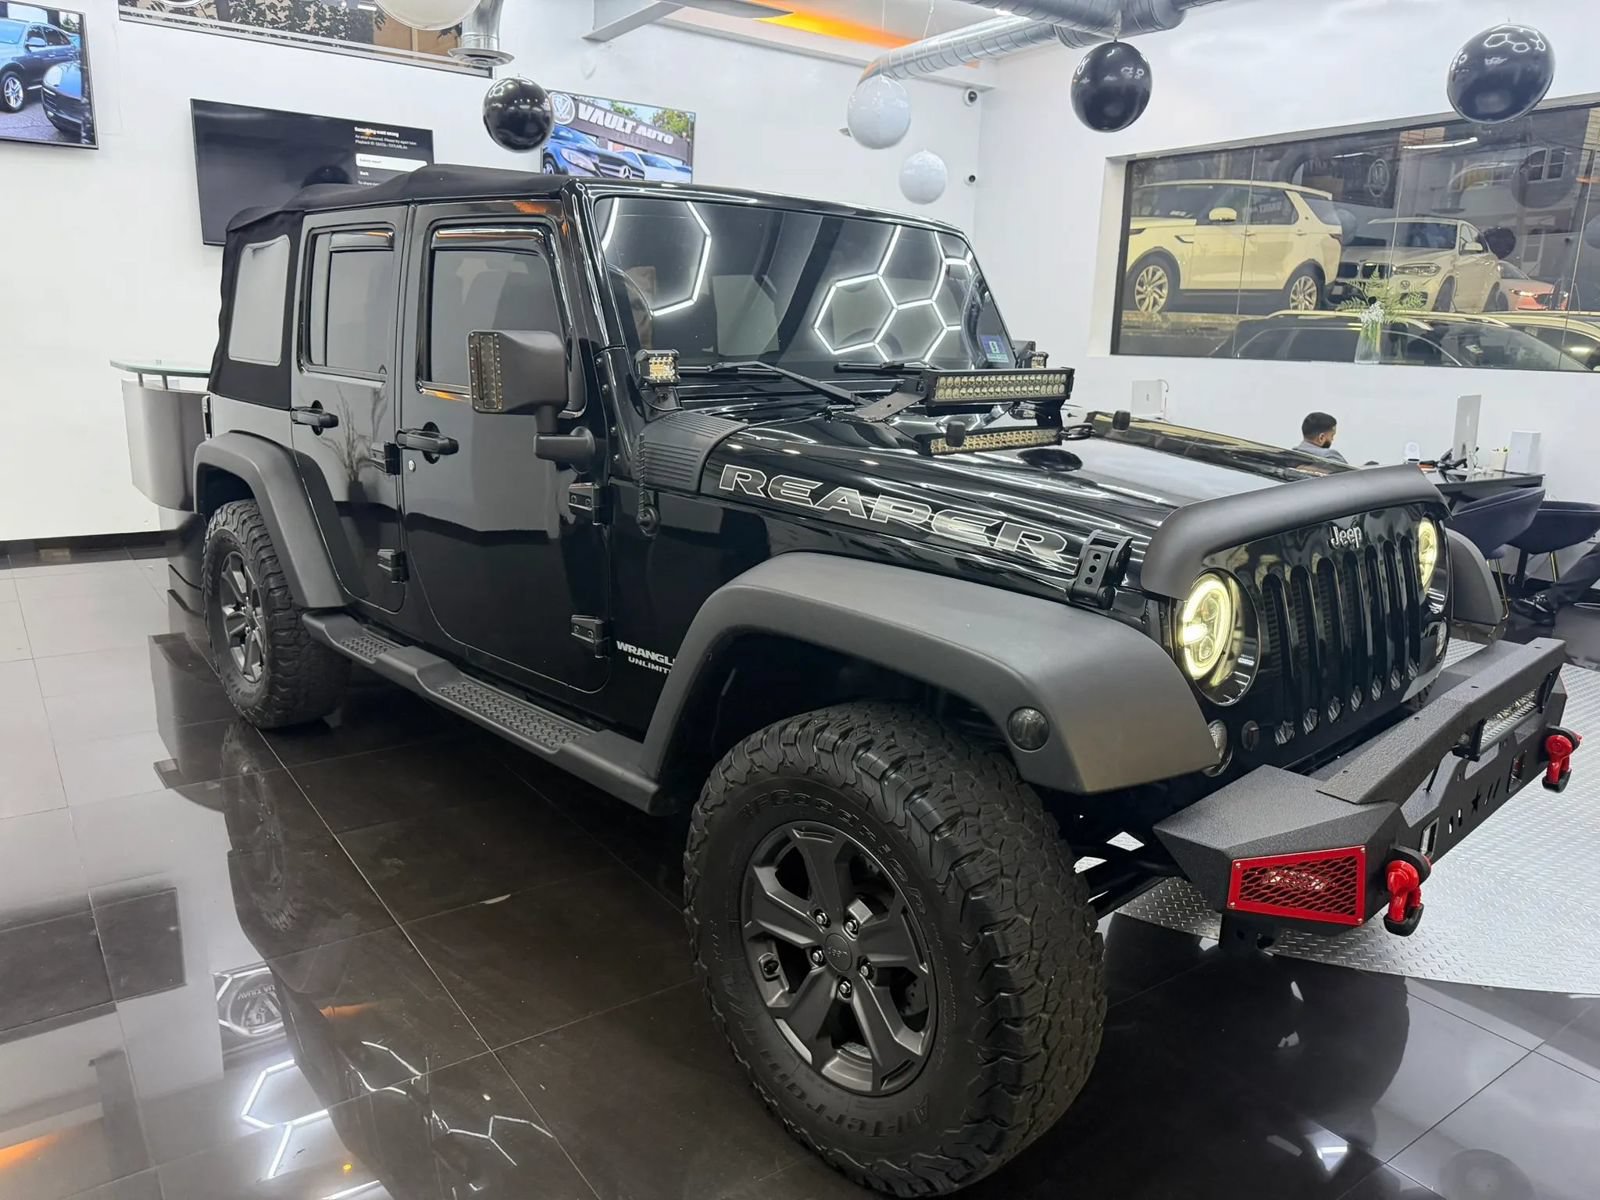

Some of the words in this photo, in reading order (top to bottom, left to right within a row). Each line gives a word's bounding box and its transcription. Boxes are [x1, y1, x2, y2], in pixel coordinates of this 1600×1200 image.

[578, 102, 636, 134] VAULT
[635, 124, 674, 145] AUTO
[719, 464, 1077, 575] REAPER
[1330, 525, 1362, 549] Jeep
